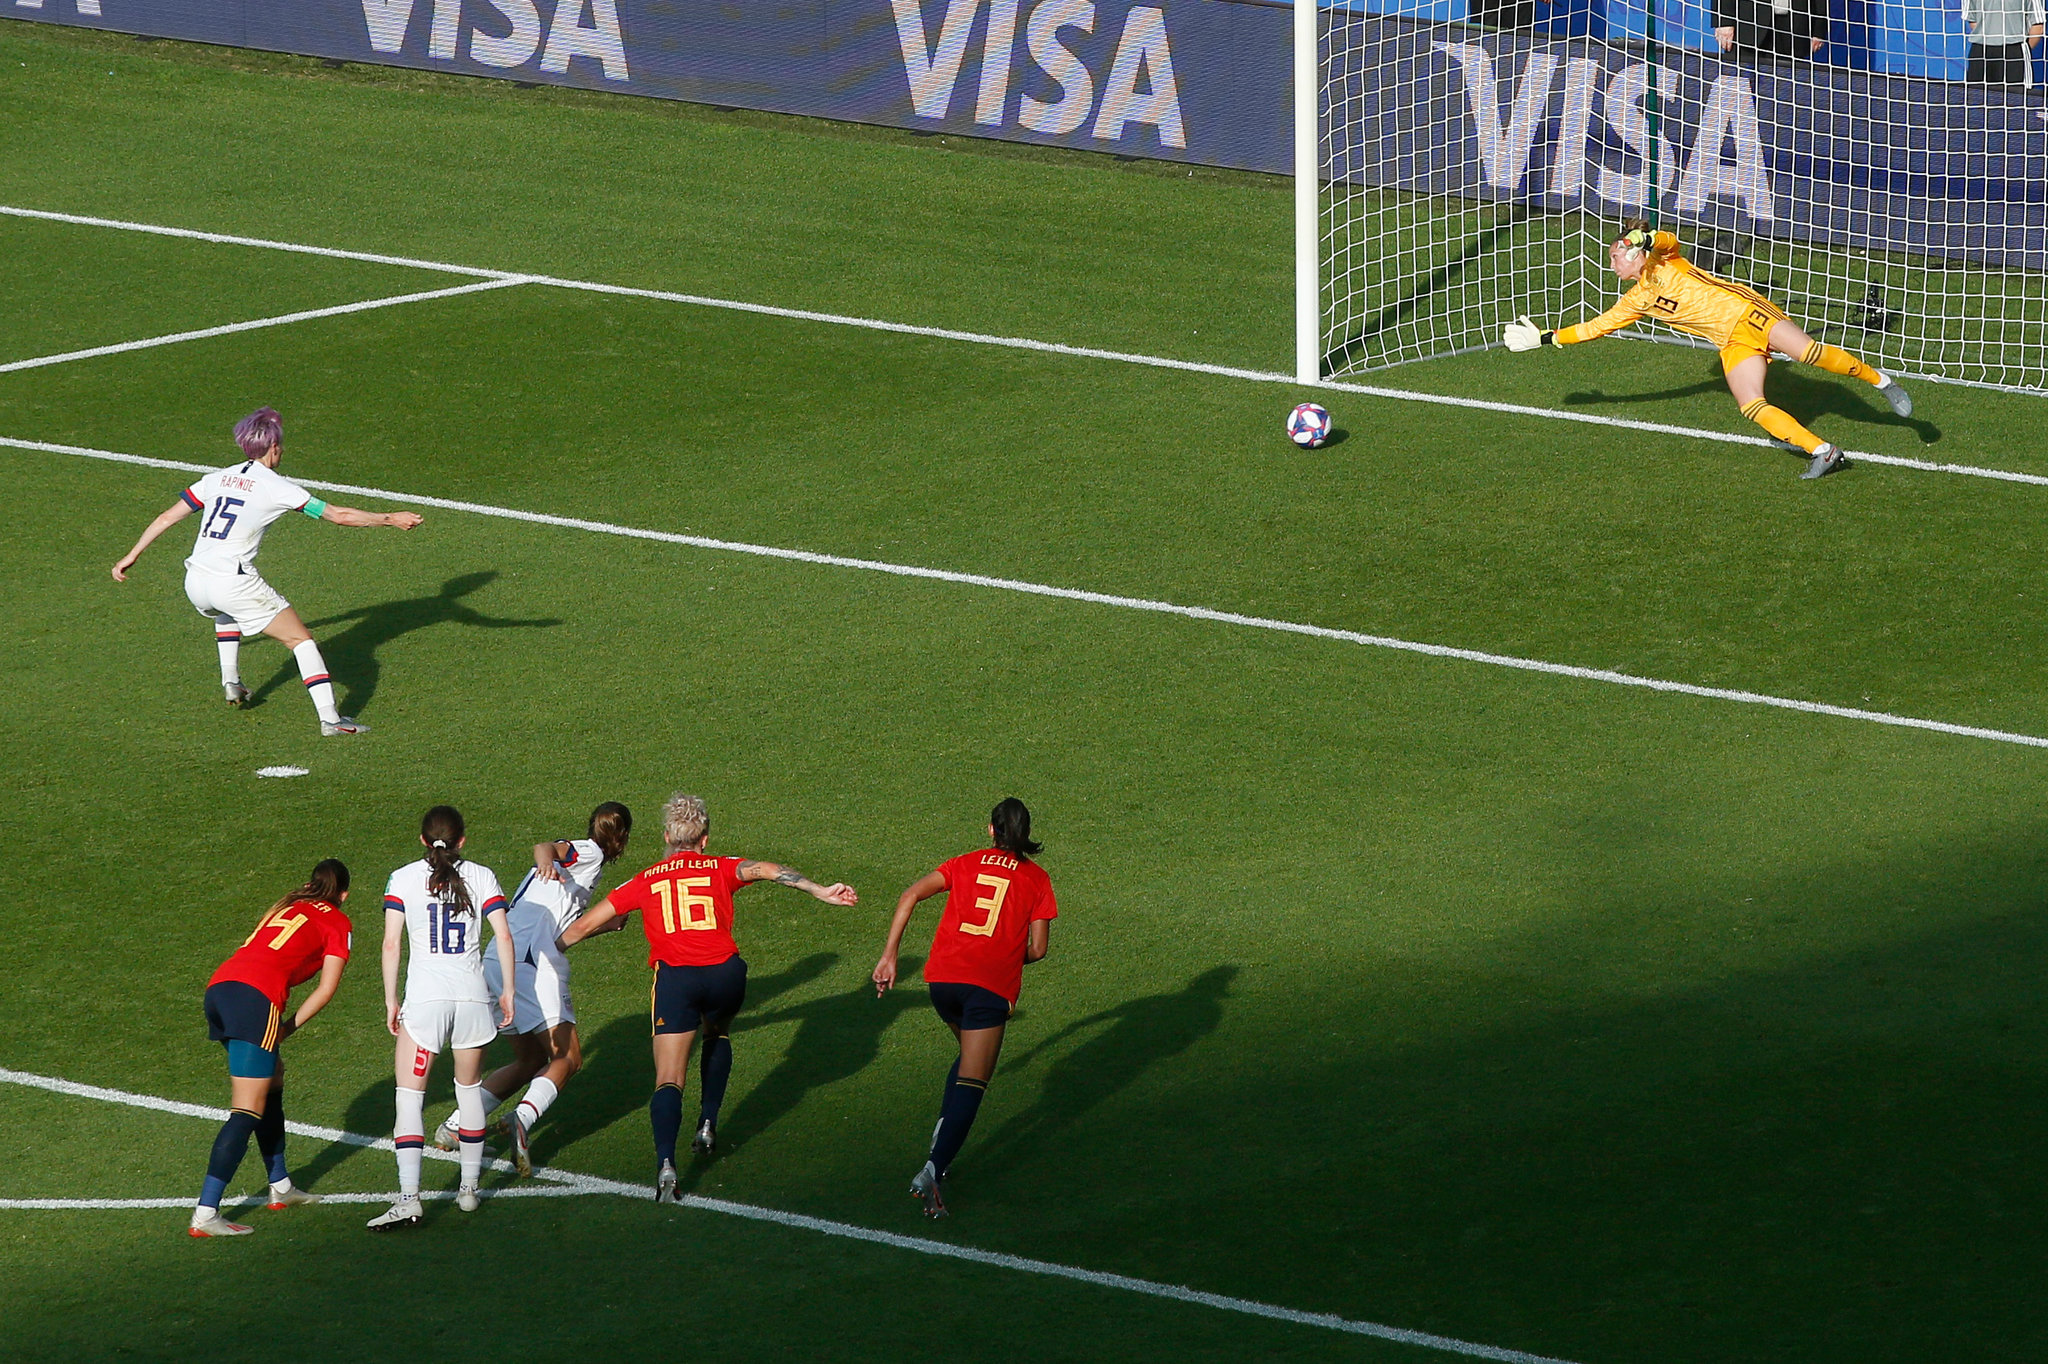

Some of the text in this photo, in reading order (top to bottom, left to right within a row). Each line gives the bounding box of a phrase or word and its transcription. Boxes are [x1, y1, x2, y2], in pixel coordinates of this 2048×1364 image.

[891, 0, 1187, 149] VISA
[1433, 40, 1773, 220] VISA
[1653, 295, 1678, 314] 13
[1748, 309, 1769, 331] 13
[202, 496, 245, 540] 15
[980, 854, 1019, 871] LEILA
[427, 903, 466, 954] 16
[650, 876, 717, 934] 16
[959, 873, 1010, 937] 3
